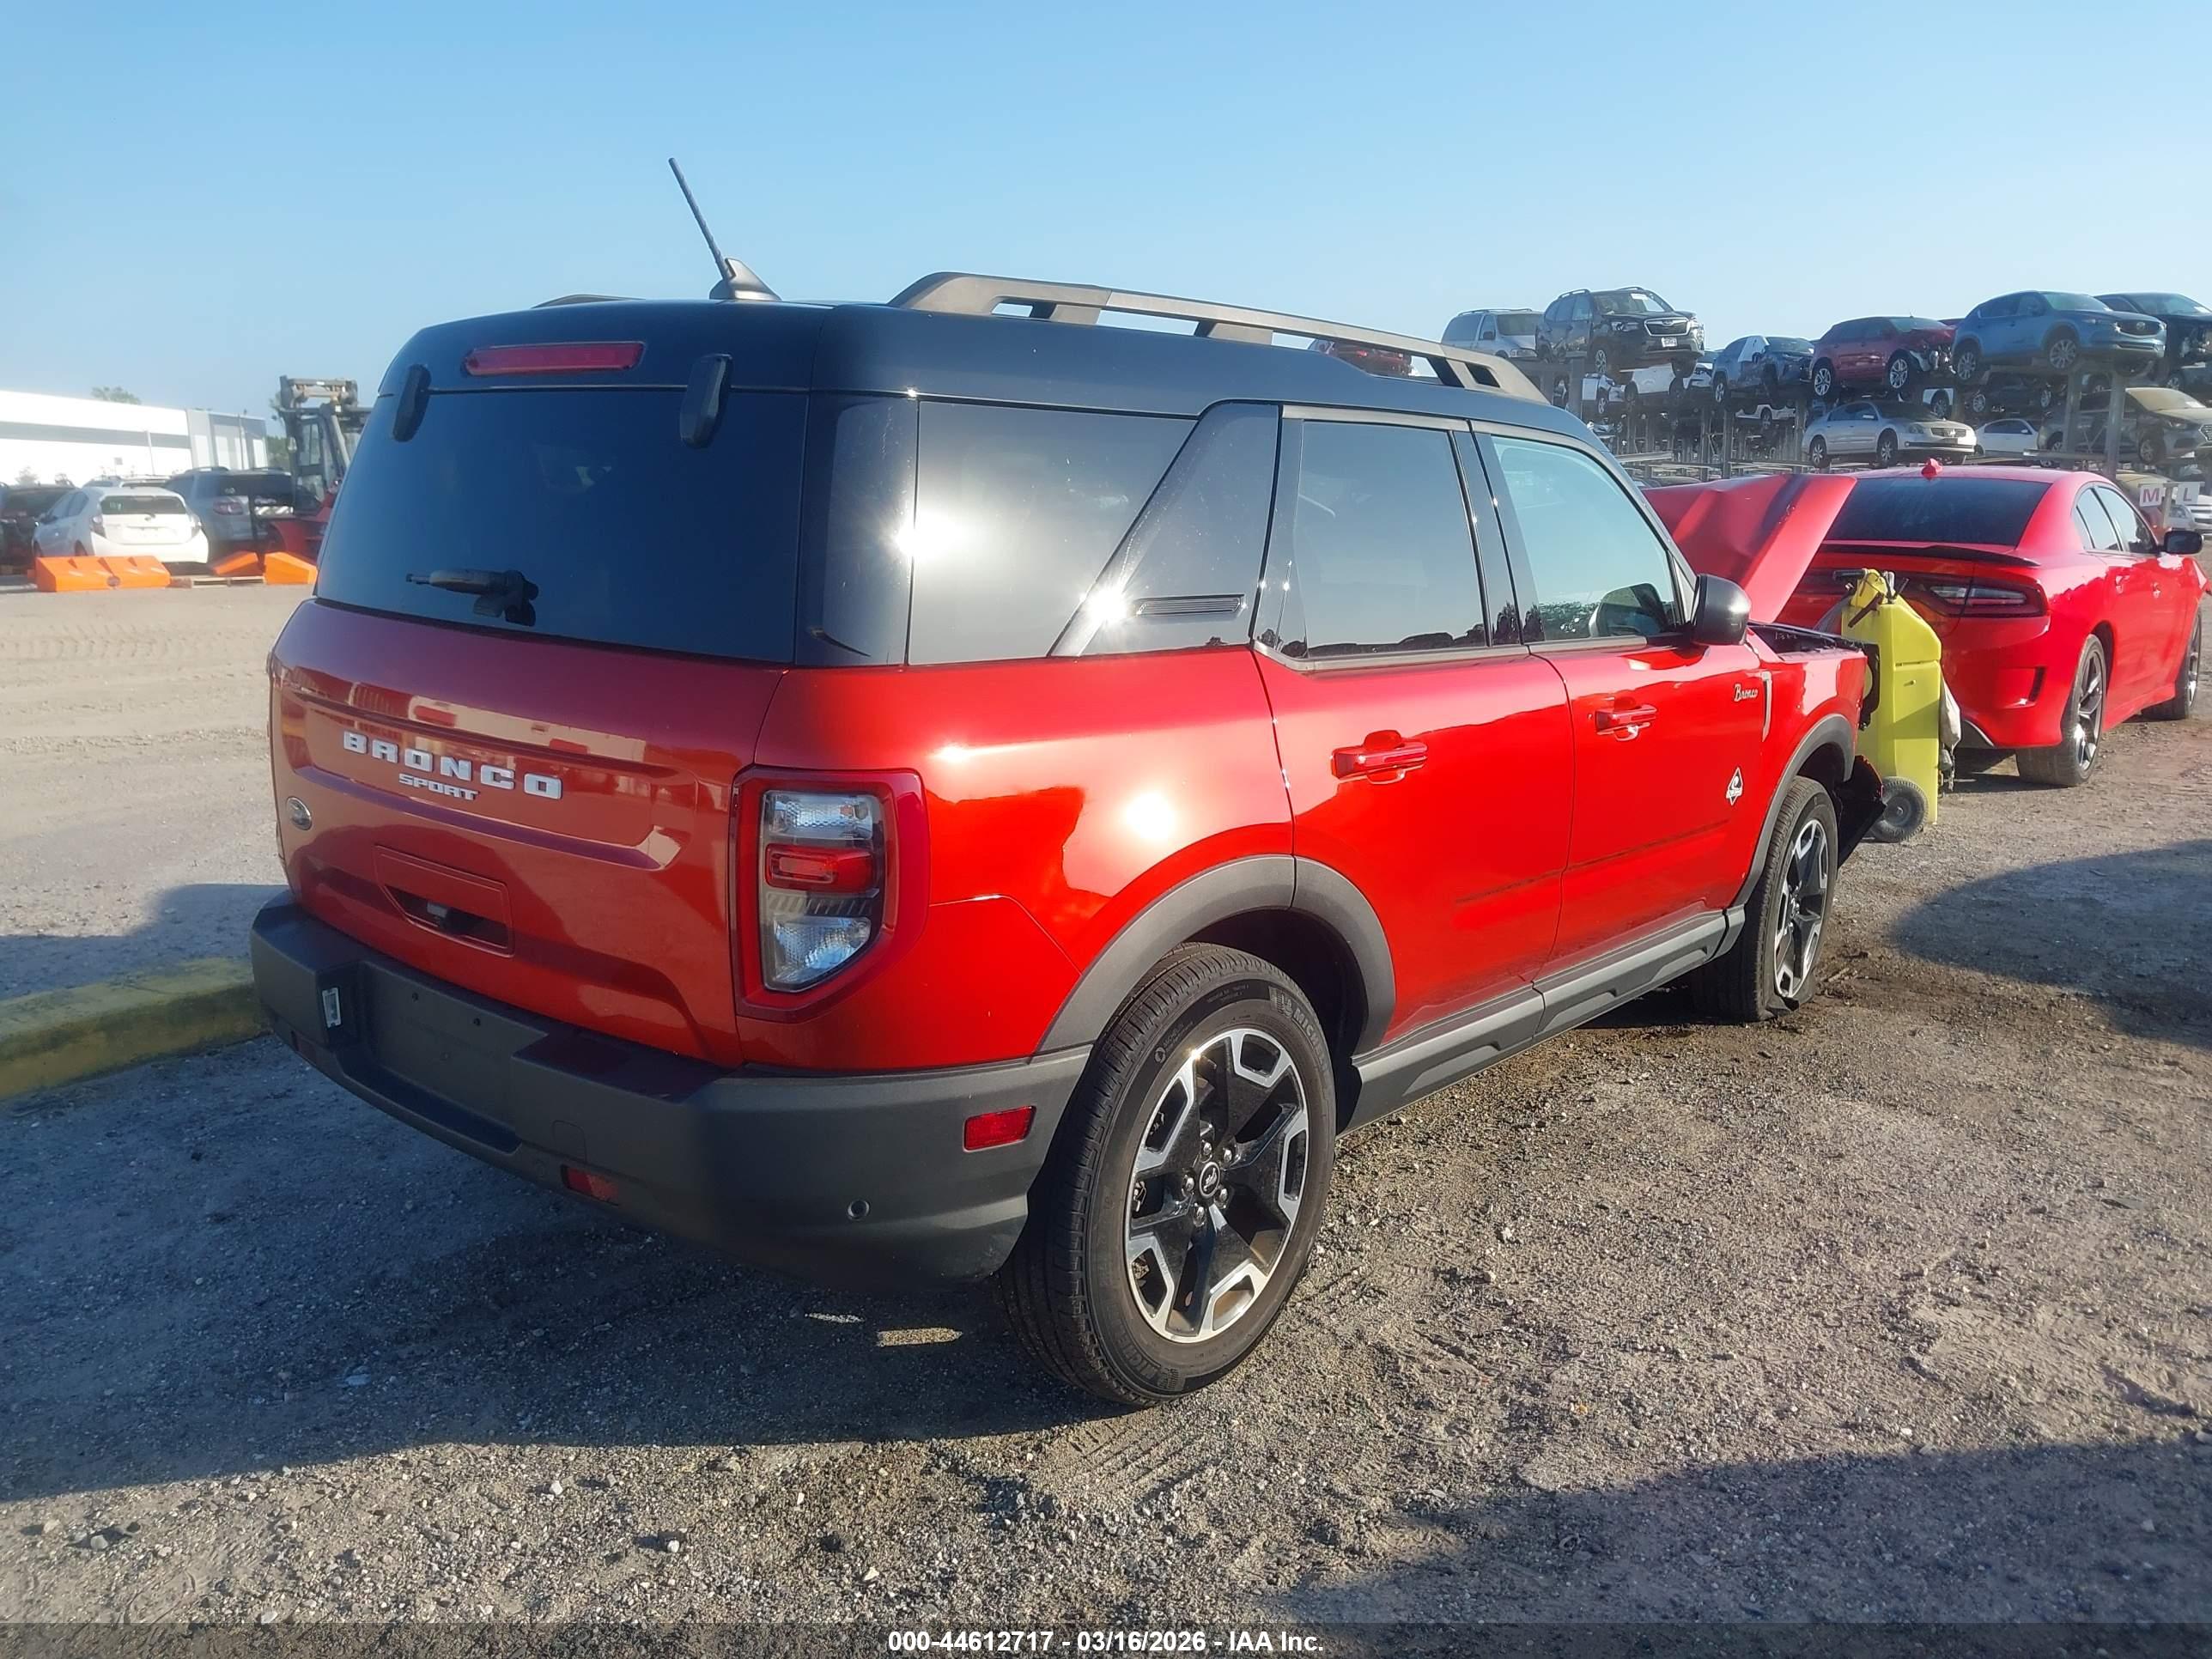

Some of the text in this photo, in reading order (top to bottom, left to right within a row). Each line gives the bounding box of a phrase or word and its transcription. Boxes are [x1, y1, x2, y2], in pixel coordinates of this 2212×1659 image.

[2142, 487, 2160, 502] M
[2183, 487, 2192, 501] L
[1734, 684, 1759, 702] Bronco
[343, 731, 562, 799] BRONCO
[398, 773, 480, 800] SPORT
